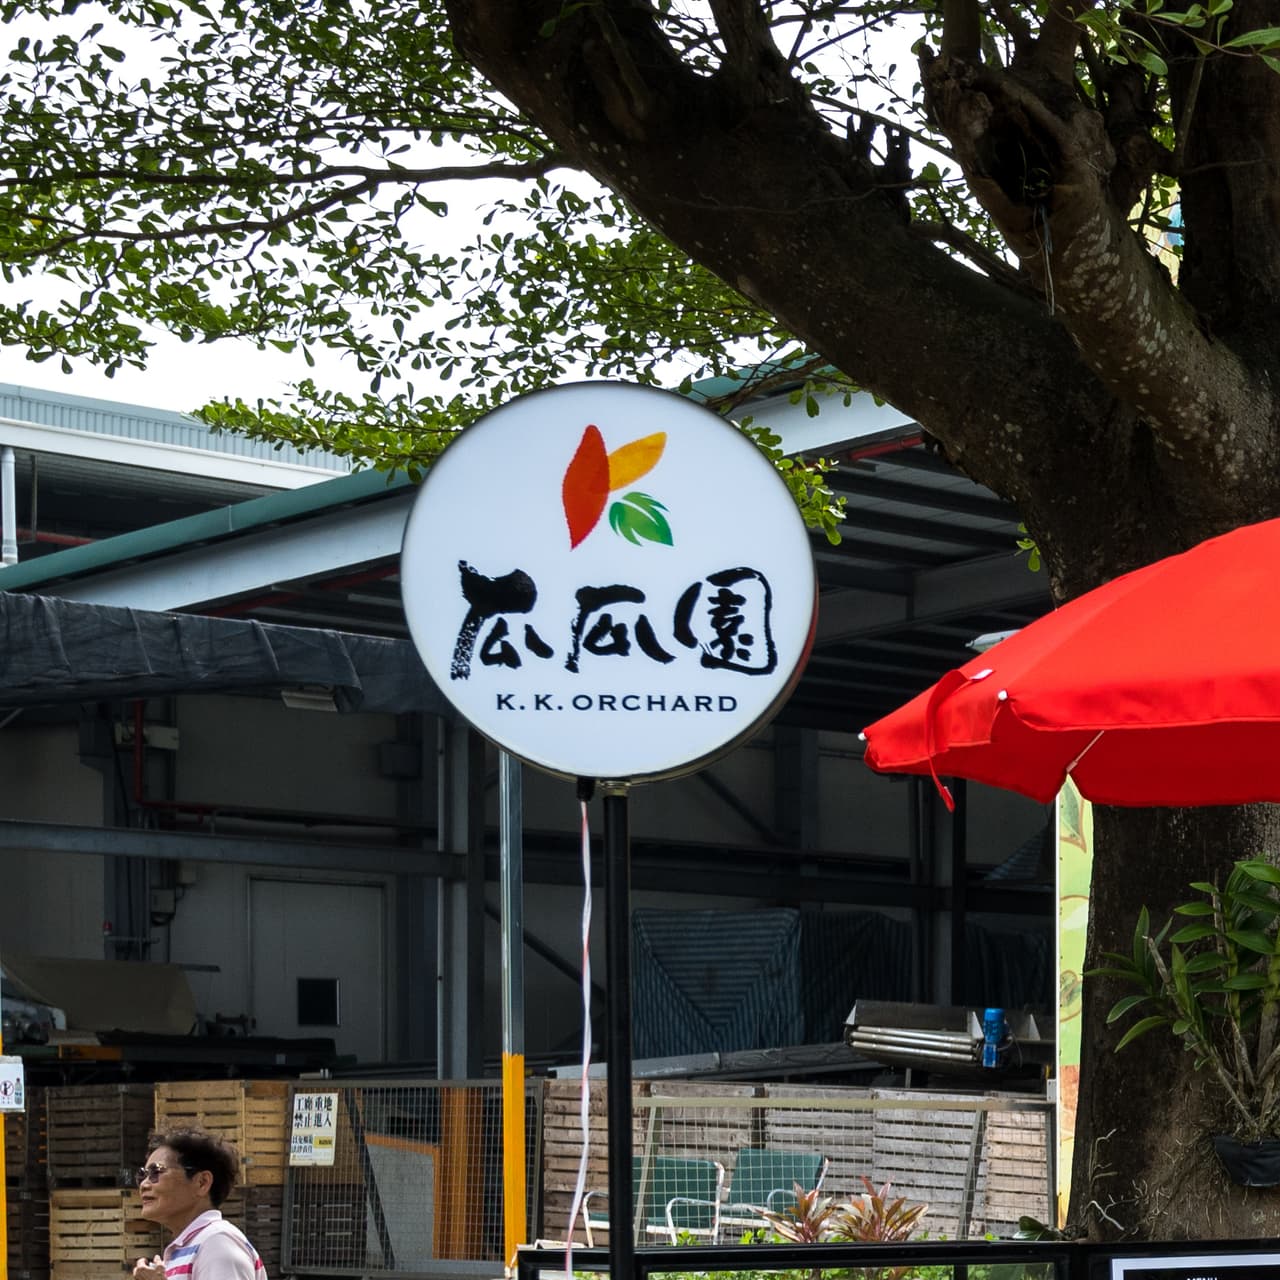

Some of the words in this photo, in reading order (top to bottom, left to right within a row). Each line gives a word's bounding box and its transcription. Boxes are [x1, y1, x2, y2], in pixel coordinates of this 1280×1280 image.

[296, 1095, 333, 1111] 工廠重地
[294, 1112, 332, 1128] 禁止進入
